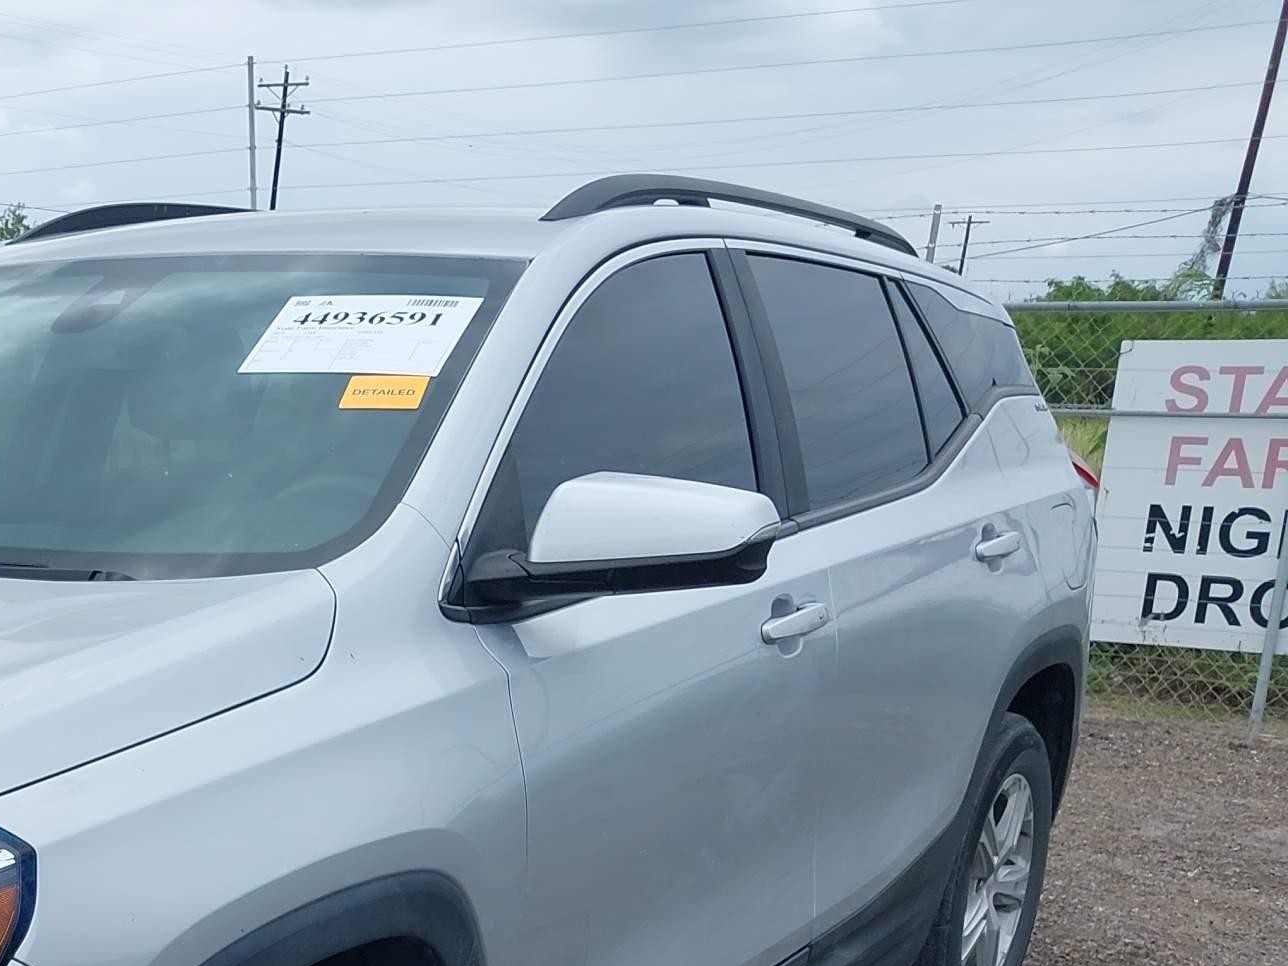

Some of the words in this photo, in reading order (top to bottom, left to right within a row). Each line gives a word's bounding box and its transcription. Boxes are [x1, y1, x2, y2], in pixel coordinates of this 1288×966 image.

[293, 311, 444, 327] 44936591
[352, 388, 416, 396] DETAILED
[1142, 504, 1288, 559] NIG
